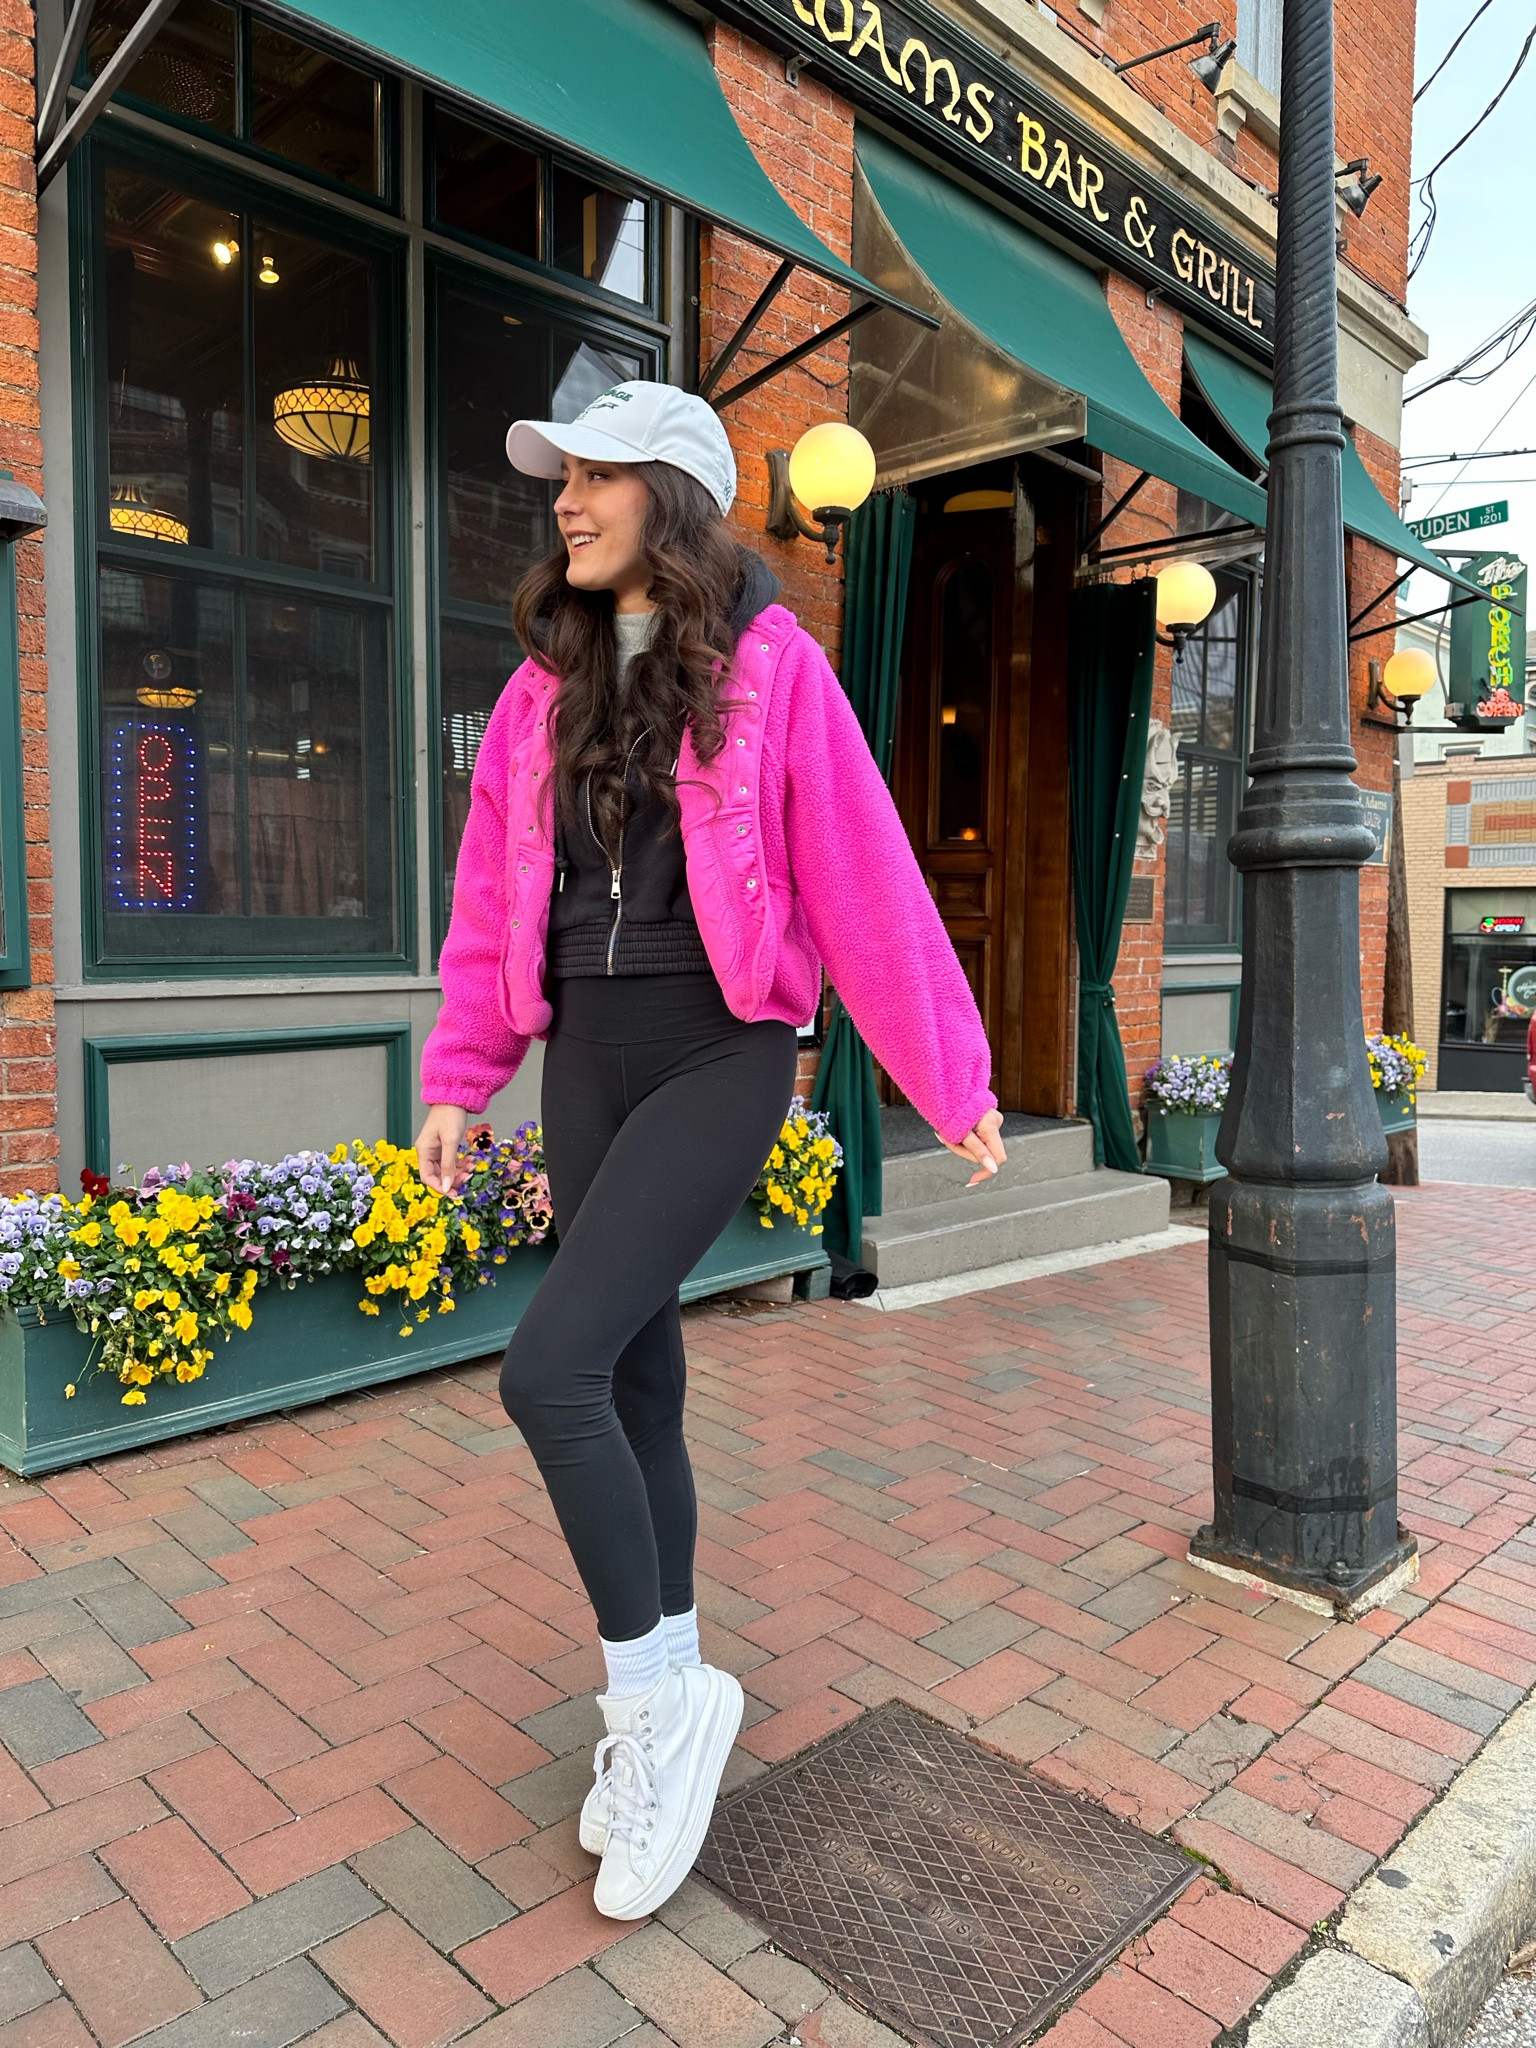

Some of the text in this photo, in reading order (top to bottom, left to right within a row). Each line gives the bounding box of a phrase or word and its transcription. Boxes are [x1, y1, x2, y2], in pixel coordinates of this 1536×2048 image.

[1017, 112, 1109, 222] BAR
[1124, 197, 1157, 258] &
[1171, 228, 1262, 329] GRILL
[1480, 512, 1502, 525] 1201
[1485, 505, 1495, 514] ST
[1488, 584, 1513, 687] PORCH
[138, 734, 173, 899] OPEN
[868, 1770, 942, 1816] NEENAH
[949, 1817, 1044, 1873] FOUNDRY
